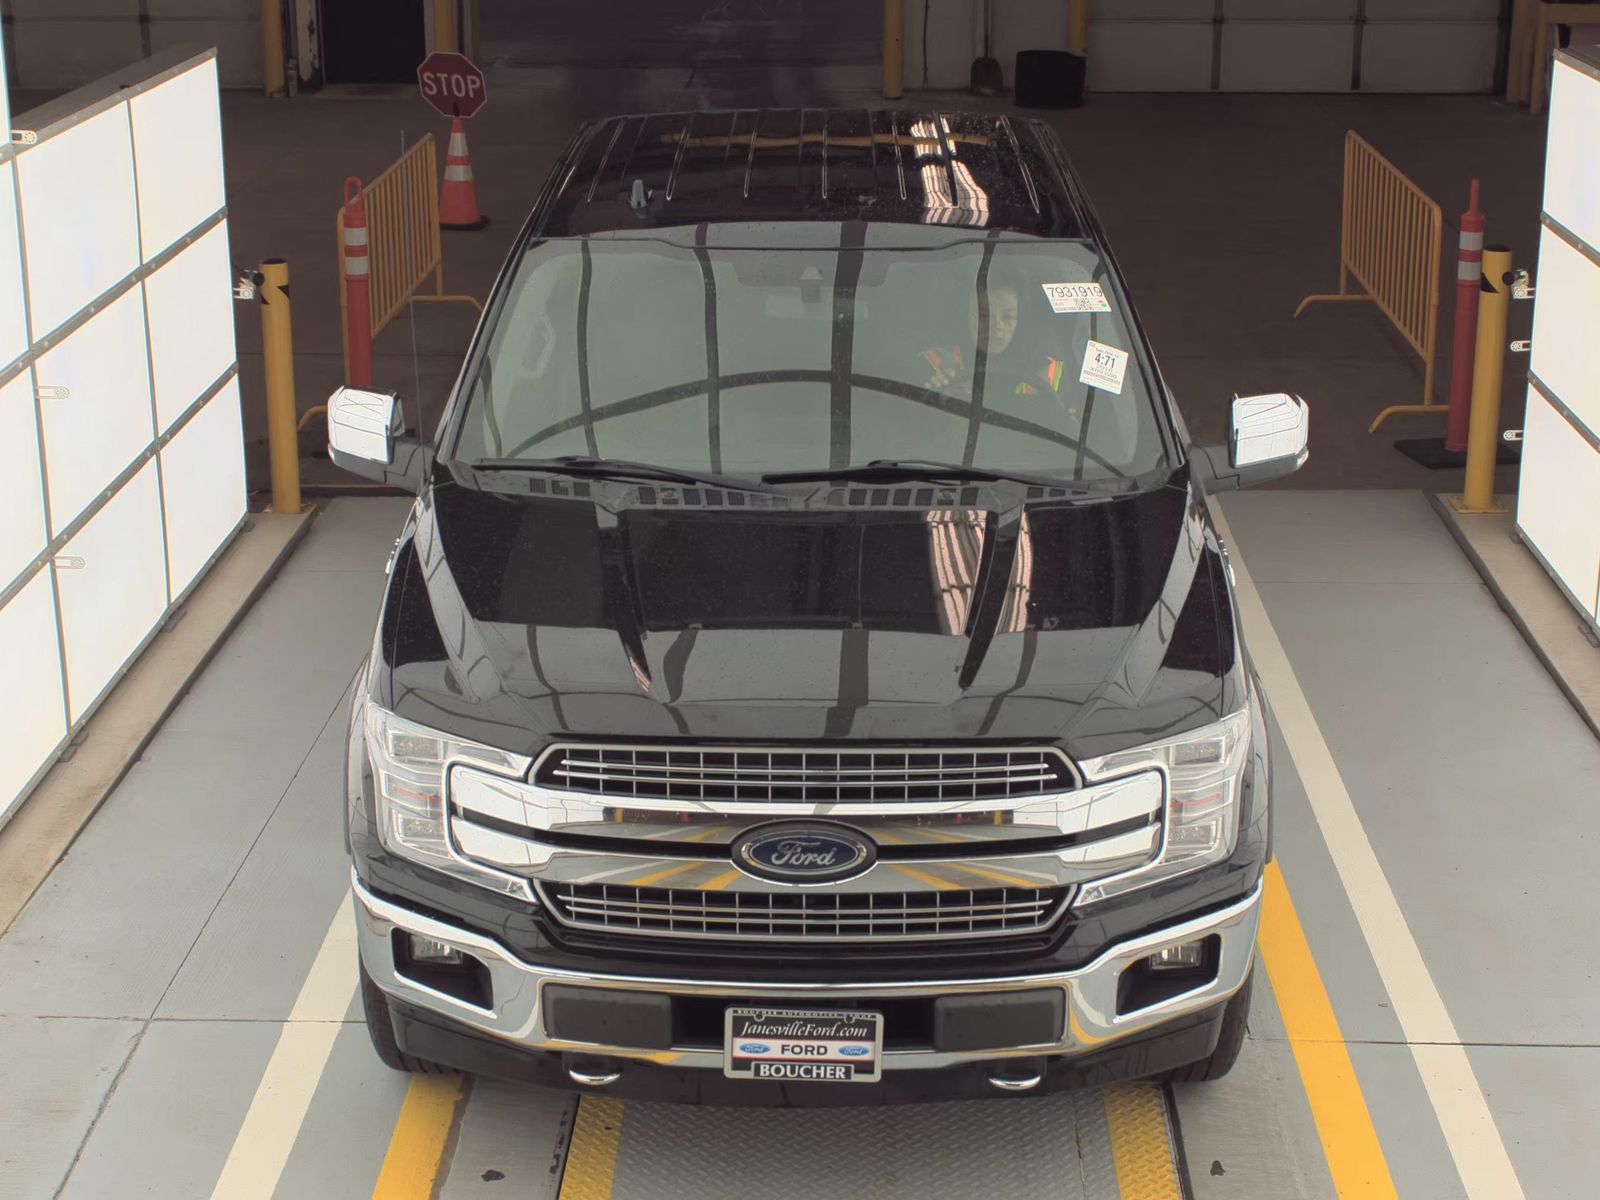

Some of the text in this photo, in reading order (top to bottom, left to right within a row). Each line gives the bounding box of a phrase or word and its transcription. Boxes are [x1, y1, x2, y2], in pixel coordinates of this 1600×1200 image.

[423, 72, 481, 98] STOP
[1046, 286, 1103, 298] 7931919
[1094, 353, 1115, 368] 4:71
[771, 840, 838, 866] Ford
[740, 1021, 868, 1038] JanesvilleFord.com
[781, 1044, 828, 1056] FORD
[760, 1064, 846, 1079] BOUCHER
